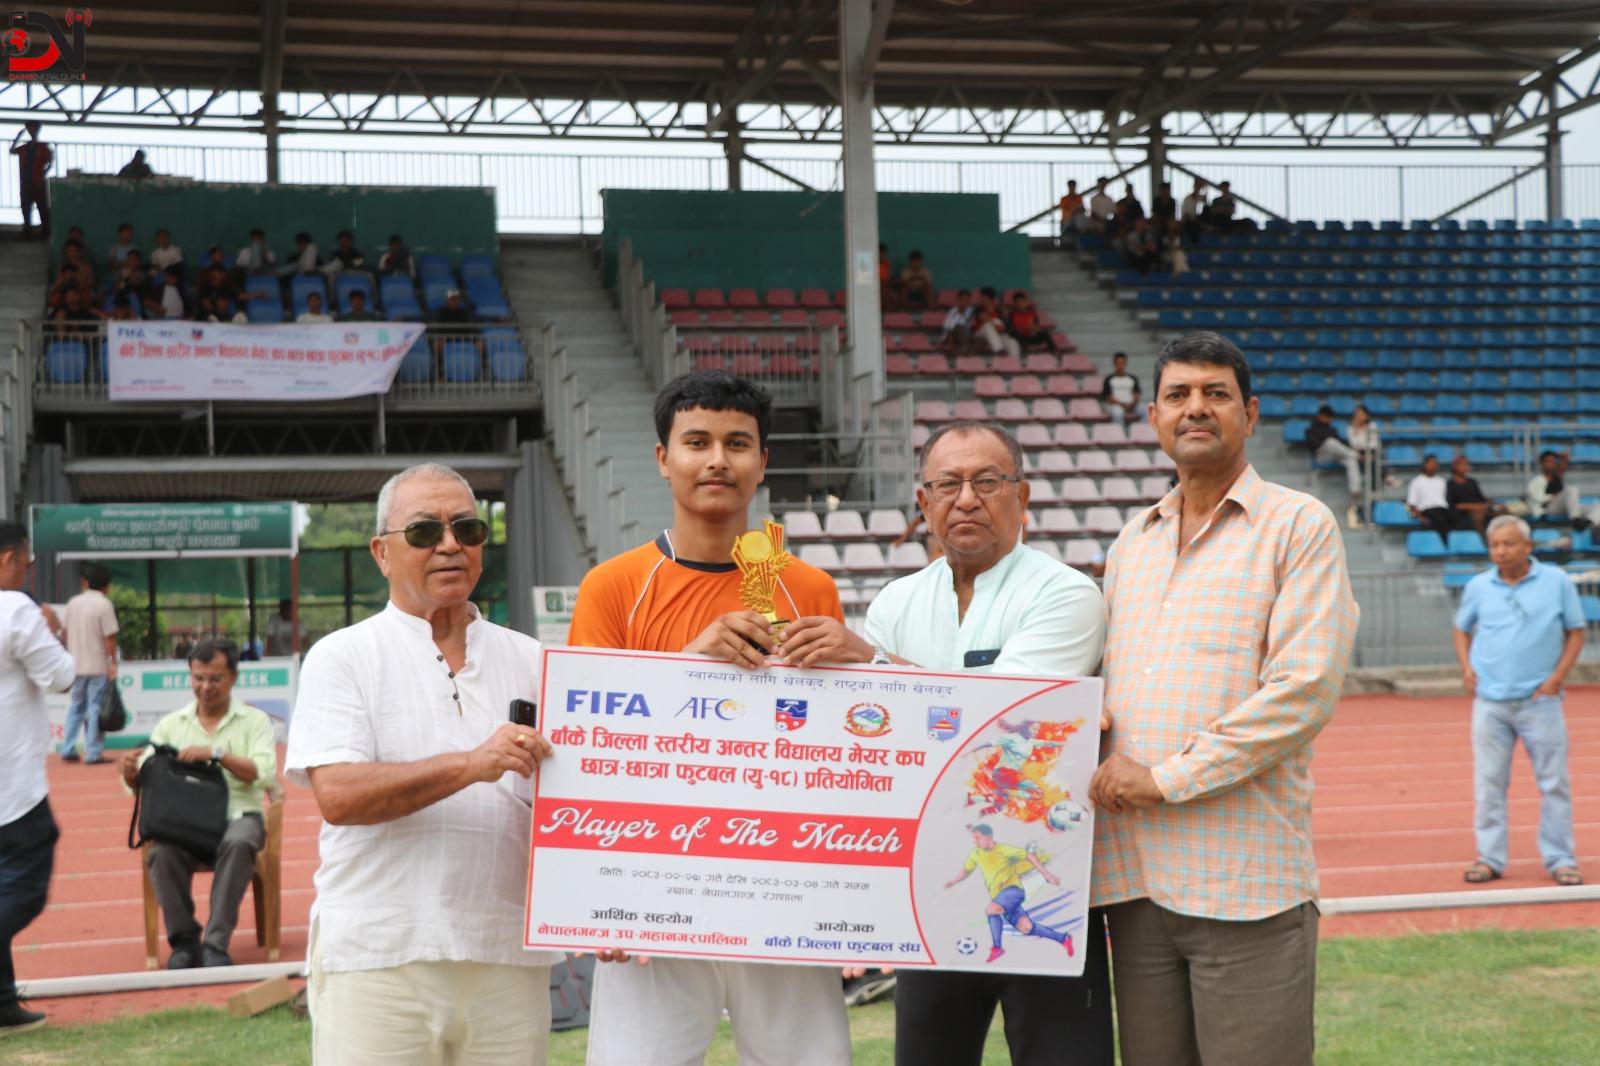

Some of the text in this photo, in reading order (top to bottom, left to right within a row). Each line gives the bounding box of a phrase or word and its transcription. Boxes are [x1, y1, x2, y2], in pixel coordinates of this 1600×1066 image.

[750, 673, 776, 685] लागि
[880, 680, 906, 693] लागि
[566, 689, 652, 717] FIFA
[674, 696, 740, 721] AFC
[550, 724, 926, 767] बाँके जिल्ला स्तरीय अन्तर विद्यालय मेयर कप
[676, 763, 739, 785] फुटबल
[804, 767, 894, 792] प्रतियोगिता
[540, 806, 902, 853] Player of The Match
[706, 872, 722, 883] गते
[726, 874, 747, 885] देखि
[822, 879, 840, 890] गते
[590, 908, 692, 924] आर्थिक सहयोग
[538, 922, 610, 938] नेपालगन्ज
[814, 920, 876, 933] आयोजक
[797, 936, 842, 950] जिल्ला
[847, 940, 894, 953] फुटबल
[898, 940, 921, 952] संघ
